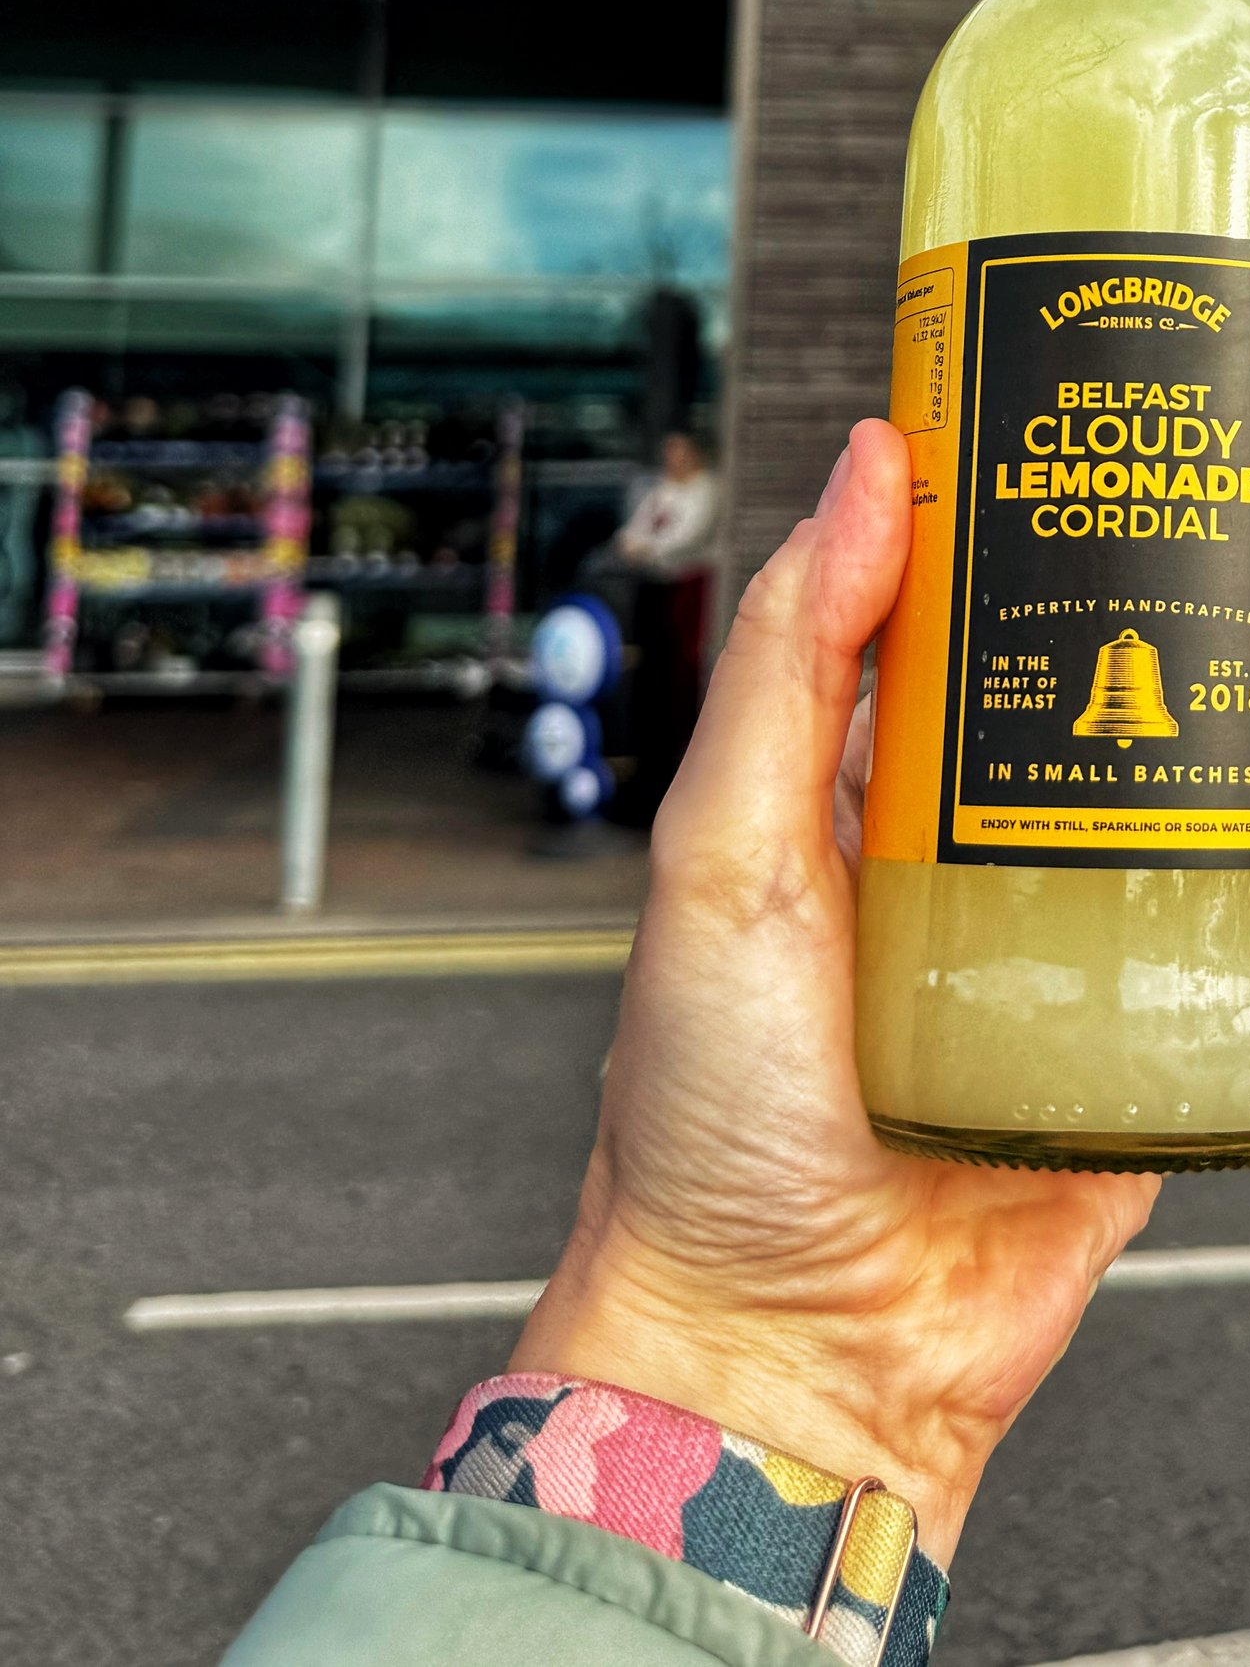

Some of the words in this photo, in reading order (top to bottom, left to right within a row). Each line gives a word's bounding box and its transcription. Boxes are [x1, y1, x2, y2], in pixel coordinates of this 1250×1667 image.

[1039, 277, 1232, 333] LONGBRIDGE
[1100, 316, 1153, 329] DRINKS
[930, 326, 945, 339] Kcal
[1058, 382, 1211, 411] BELFAST
[1024, 414, 1242, 459] CLOUDY
[912, 492, 938, 506] ulphite
[1031, 504, 1229, 541] CORDIAL
[999, 599, 1097, 622] EXPERTLY
[992, 656, 1009, 671] IN
[1017, 655, 1050, 671] THE
[1209, 660, 1249, 678] EST.
[984, 677, 1029, 689] HEART
[1037, 677, 1057, 689] OF
[983, 693, 1057, 710] BELFAST
[988, 762, 1012, 781] IN
[1027, 763, 1118, 782] SMALL
[981, 818, 1017, 830] ENJOY
[1019, 819, 1050, 831] WITH
[1054, 820, 1089, 833] STILL,
[1092, 821, 1161, 833] SPARKLING
[1165, 822, 1182, 833] OR
[1186, 822, 1217, 833] SODA
